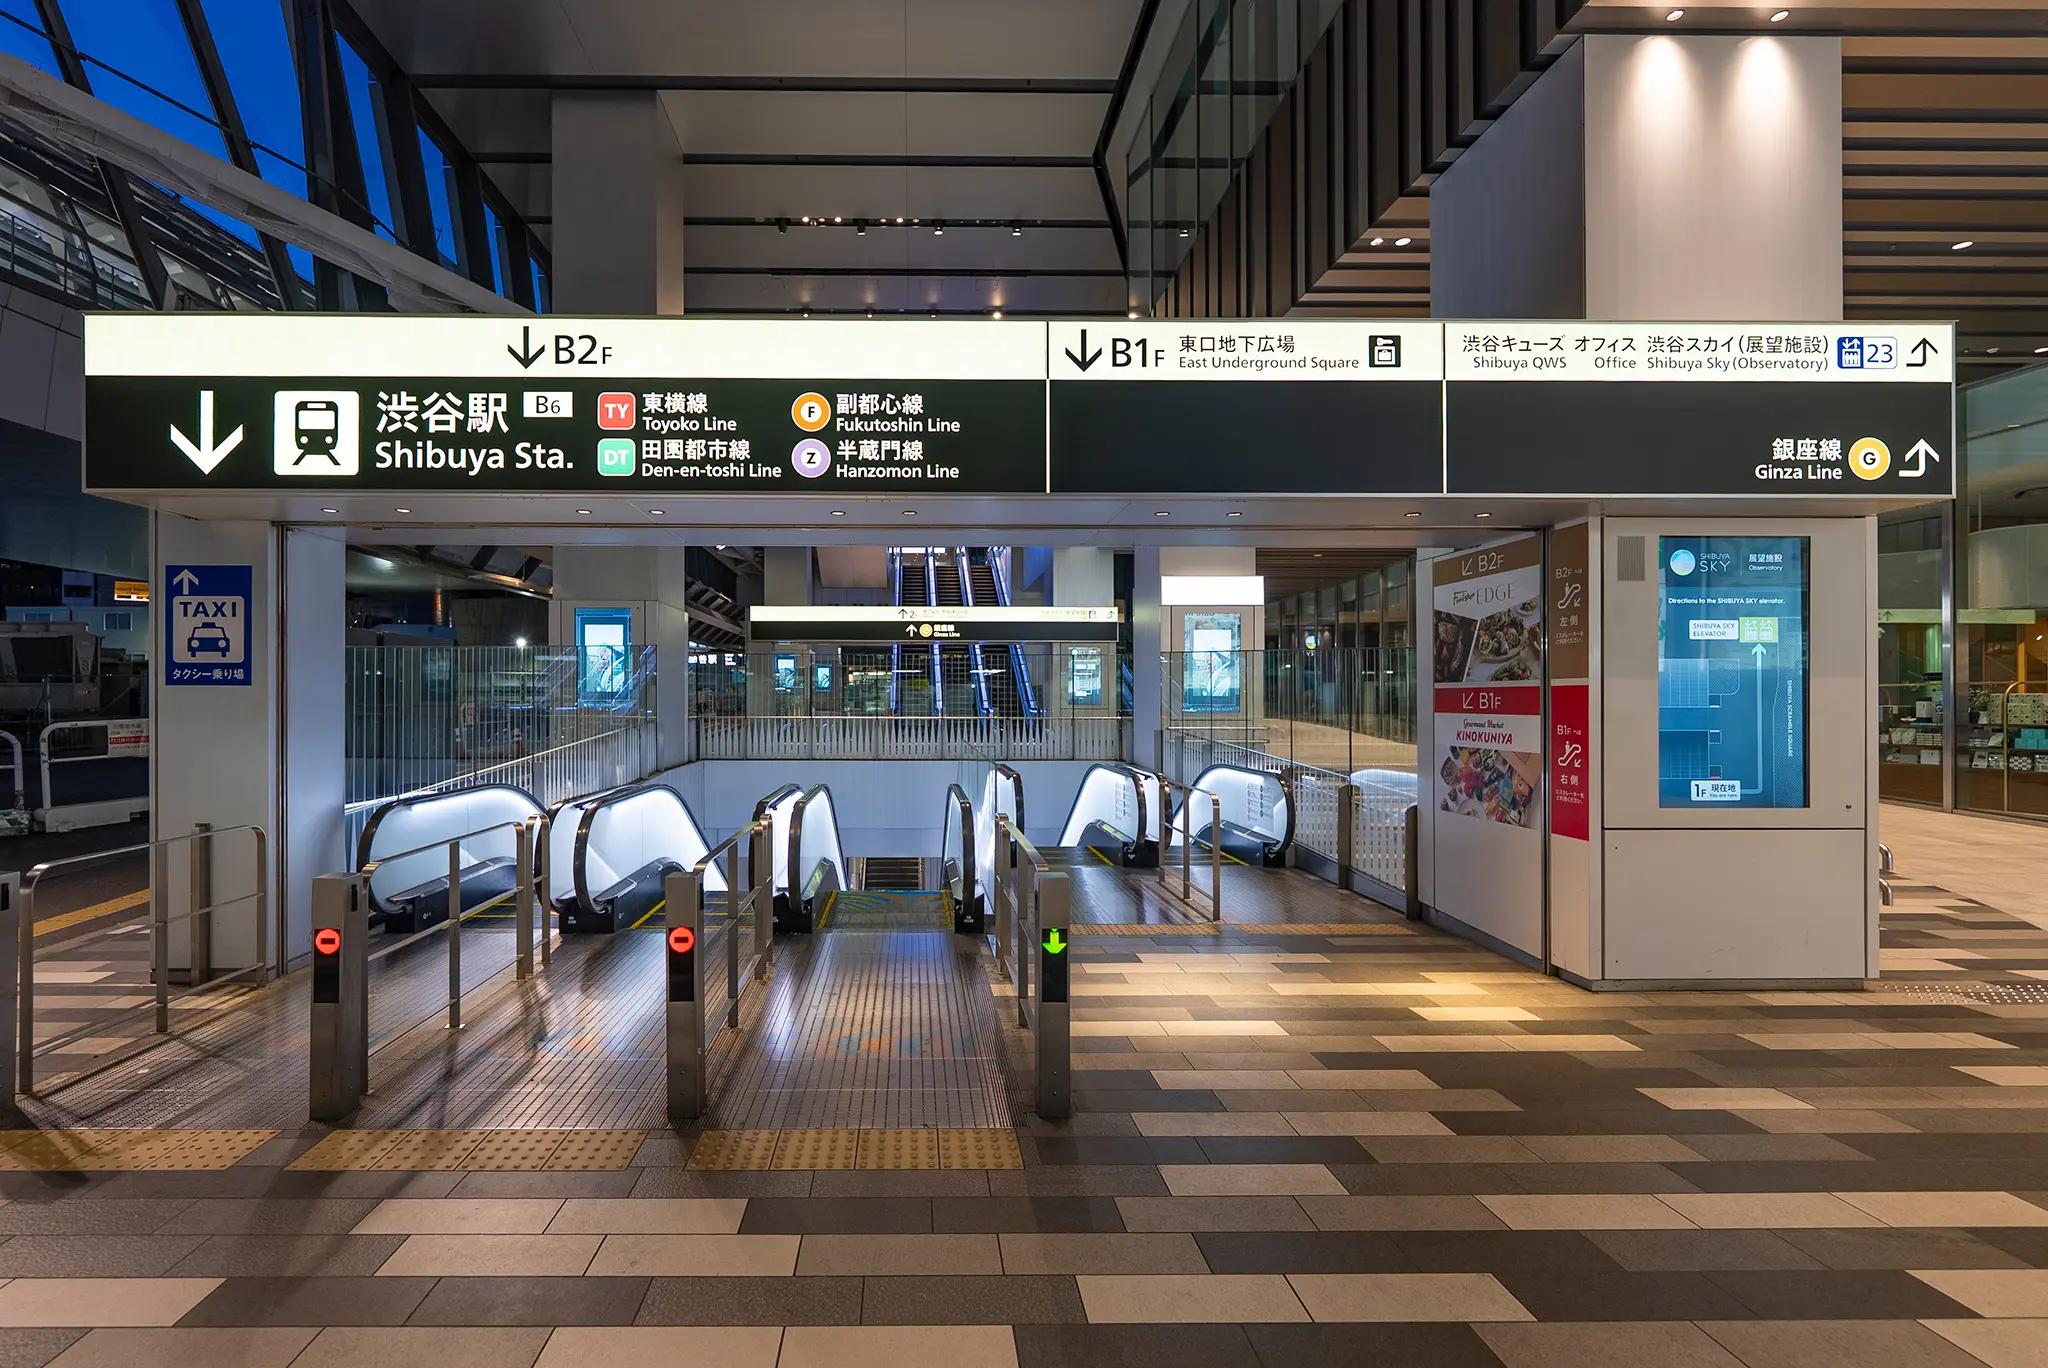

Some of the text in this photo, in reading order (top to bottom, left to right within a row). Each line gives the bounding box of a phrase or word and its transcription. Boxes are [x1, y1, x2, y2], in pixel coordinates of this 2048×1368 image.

[554, 334, 613, 365] B2F
[1179, 335, 1295, 353] 東口地下広場
[1462, 334, 1566, 353] 渋谷キューズ
[1574, 336, 1637, 353] オフィス
[1111, 338, 1165, 368] B1F
[1867, 344, 1894, 363] 23
[1180, 356, 1360, 371] East Underground Square
[1473, 356, 1529, 372] Shibuya
[1532, 356, 1567, 369] QWS
[1594, 356, 1637, 369] Office
[1647, 356, 1703, 372] Shibuya
[535, 395, 561, 414] B6
[605, 402, 630, 419] TY
[643, 392, 708, 414] 東横線
[807, 405, 816, 419] F
[836, 393, 924, 415] 副都心線
[375, 391, 510, 435] 渋谷駅
[643, 416, 738, 434] Toyoko Line
[836, 417, 961, 433] Fukutoshin Line
[375, 441, 575, 477] Shibuya Sta.
[604, 449, 630, 466] DT
[642, 439, 751, 461] 田園都市線
[806, 452, 817, 465] Z
[836, 439, 924, 462] 半蔵門線
[1771, 438, 1843, 462] 銀座線
[1863, 451, 1876, 466] G
[642, 463, 782, 479] Den-en-toshi Line
[836, 463, 960, 479] Hanzomon Line
[1755, 464, 1843, 482] Ginza Line
[1478, 552, 1505, 573] B2F
[1699, 561, 1731, 573] SKY
[1749, 553, 1783, 563] 展望施設
[1476, 581, 1516, 605] EDGE
[179, 601, 237, 618] TAXI
[172, 668, 245, 680] タクシー乗り場
[1479, 692, 1502, 710] B1F
[1456, 730, 1513, 745] KINOKUNIYA
[1694, 783, 1707, 798] 1F
[1711, 783, 1737, 793] 現在地
